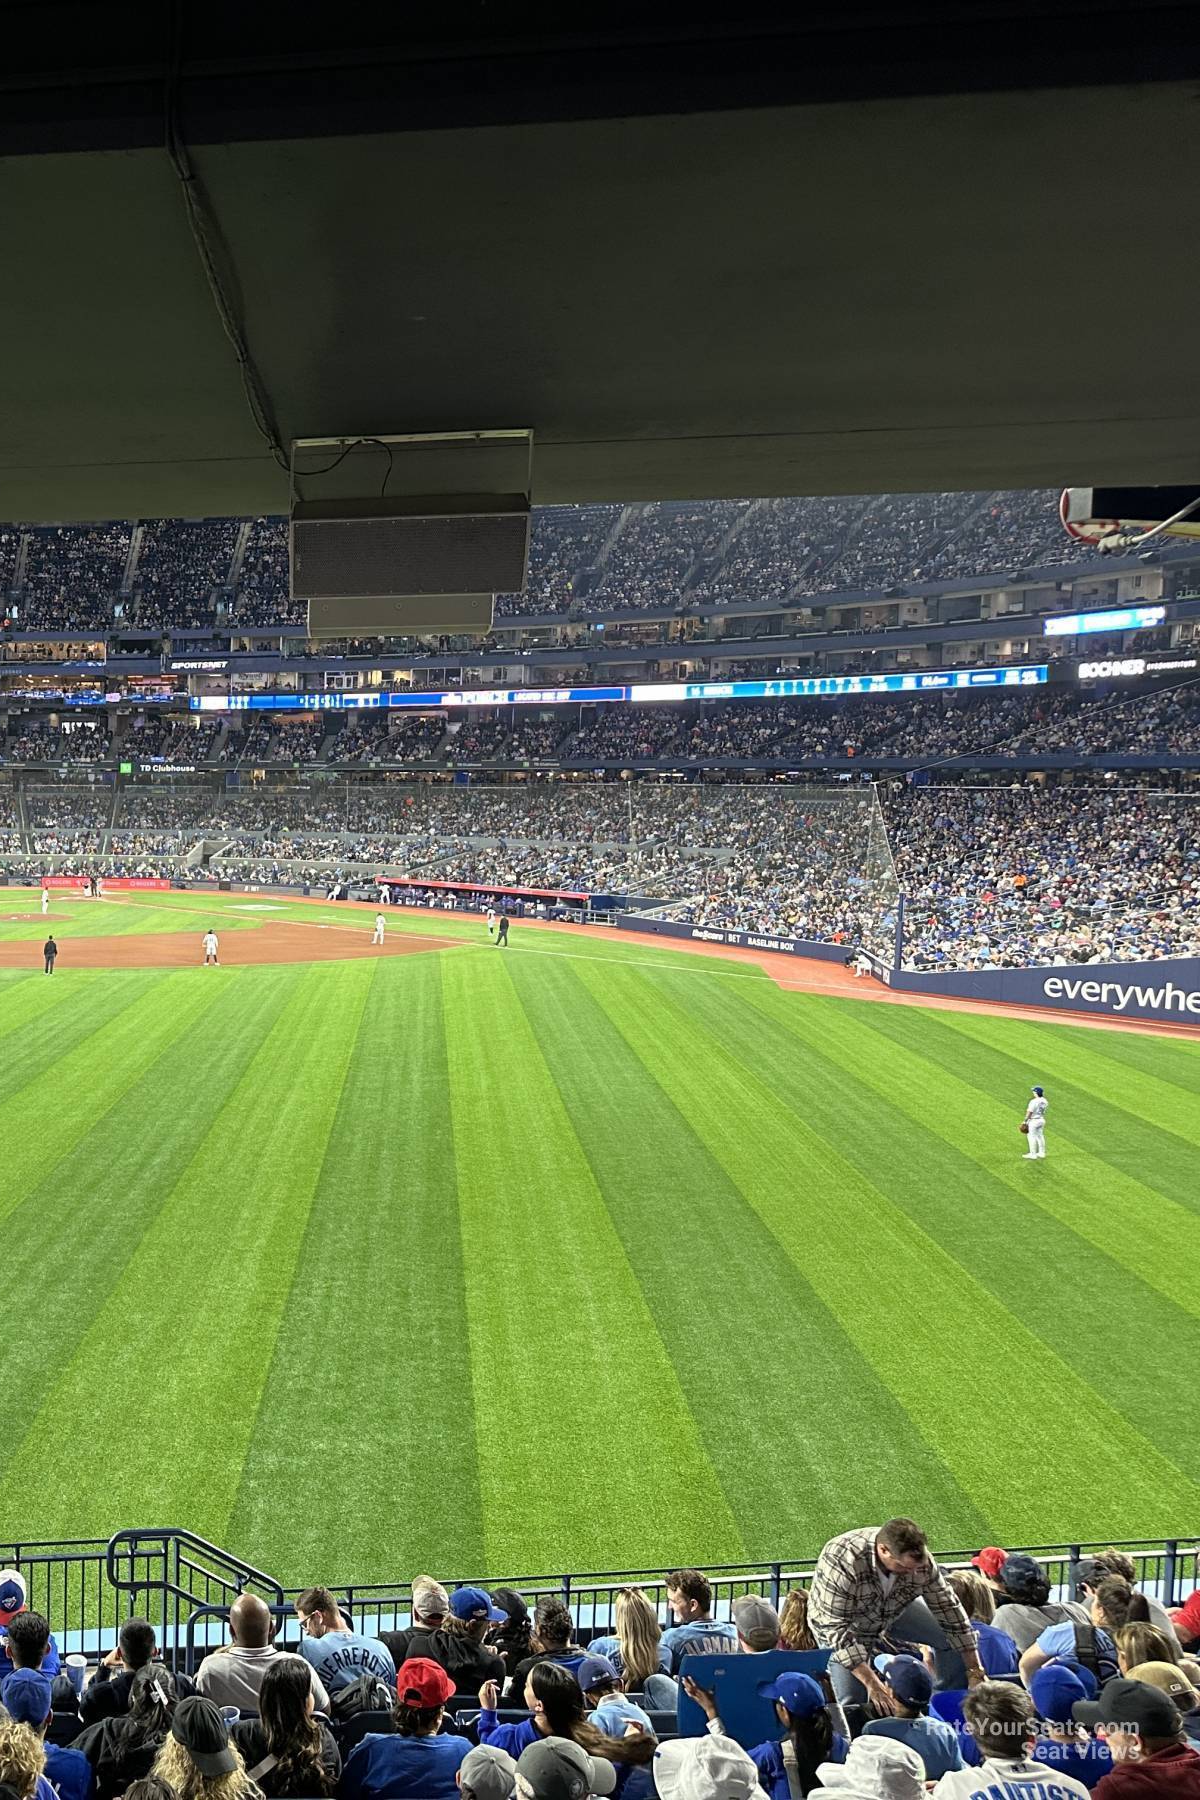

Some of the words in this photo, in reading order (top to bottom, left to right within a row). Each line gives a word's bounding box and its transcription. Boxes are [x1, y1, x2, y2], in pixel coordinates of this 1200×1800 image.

[171, 661, 228, 669] SPORTSNET
[152, 764, 195, 773] Clubhouse
[728, 933, 741, 943] BET
[747, 937, 780, 949] BASELINE
[780, 941, 795, 951] BOX
[969, 1781, 1087, 1800] AUTIST
